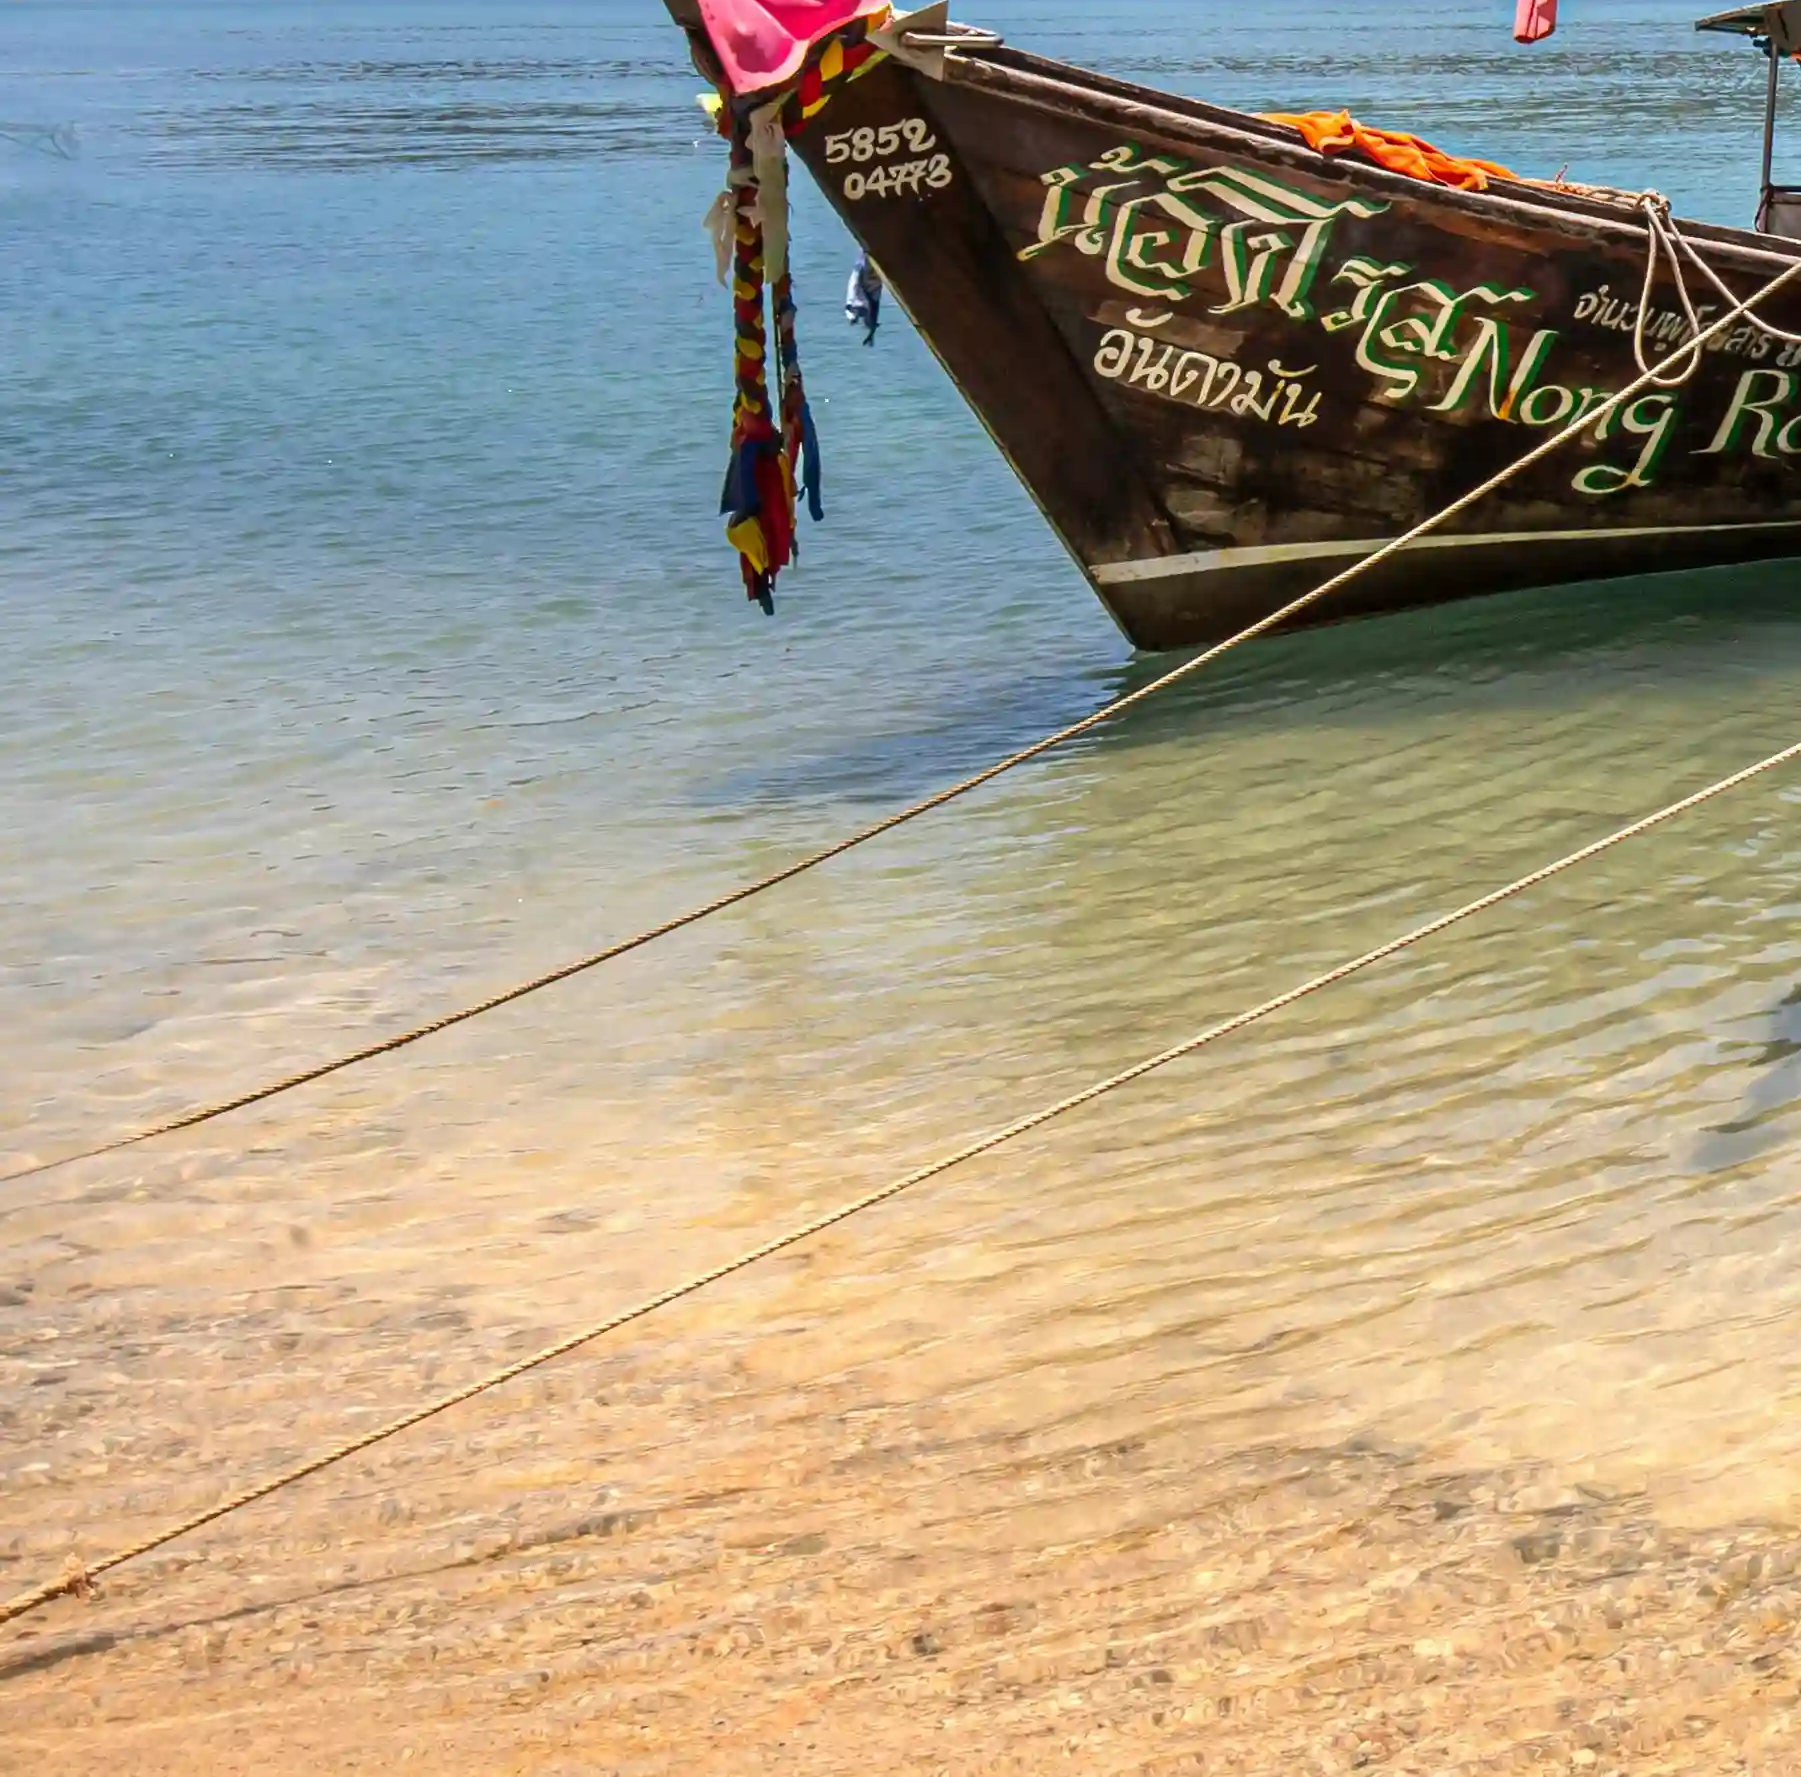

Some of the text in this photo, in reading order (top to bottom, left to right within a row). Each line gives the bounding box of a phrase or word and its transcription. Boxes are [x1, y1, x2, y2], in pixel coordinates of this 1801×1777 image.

[824, 118, 937, 164] 5852
[1093, 307, 1322, 428] อันดามัน
[1425, 314, 1678, 495] Nong
